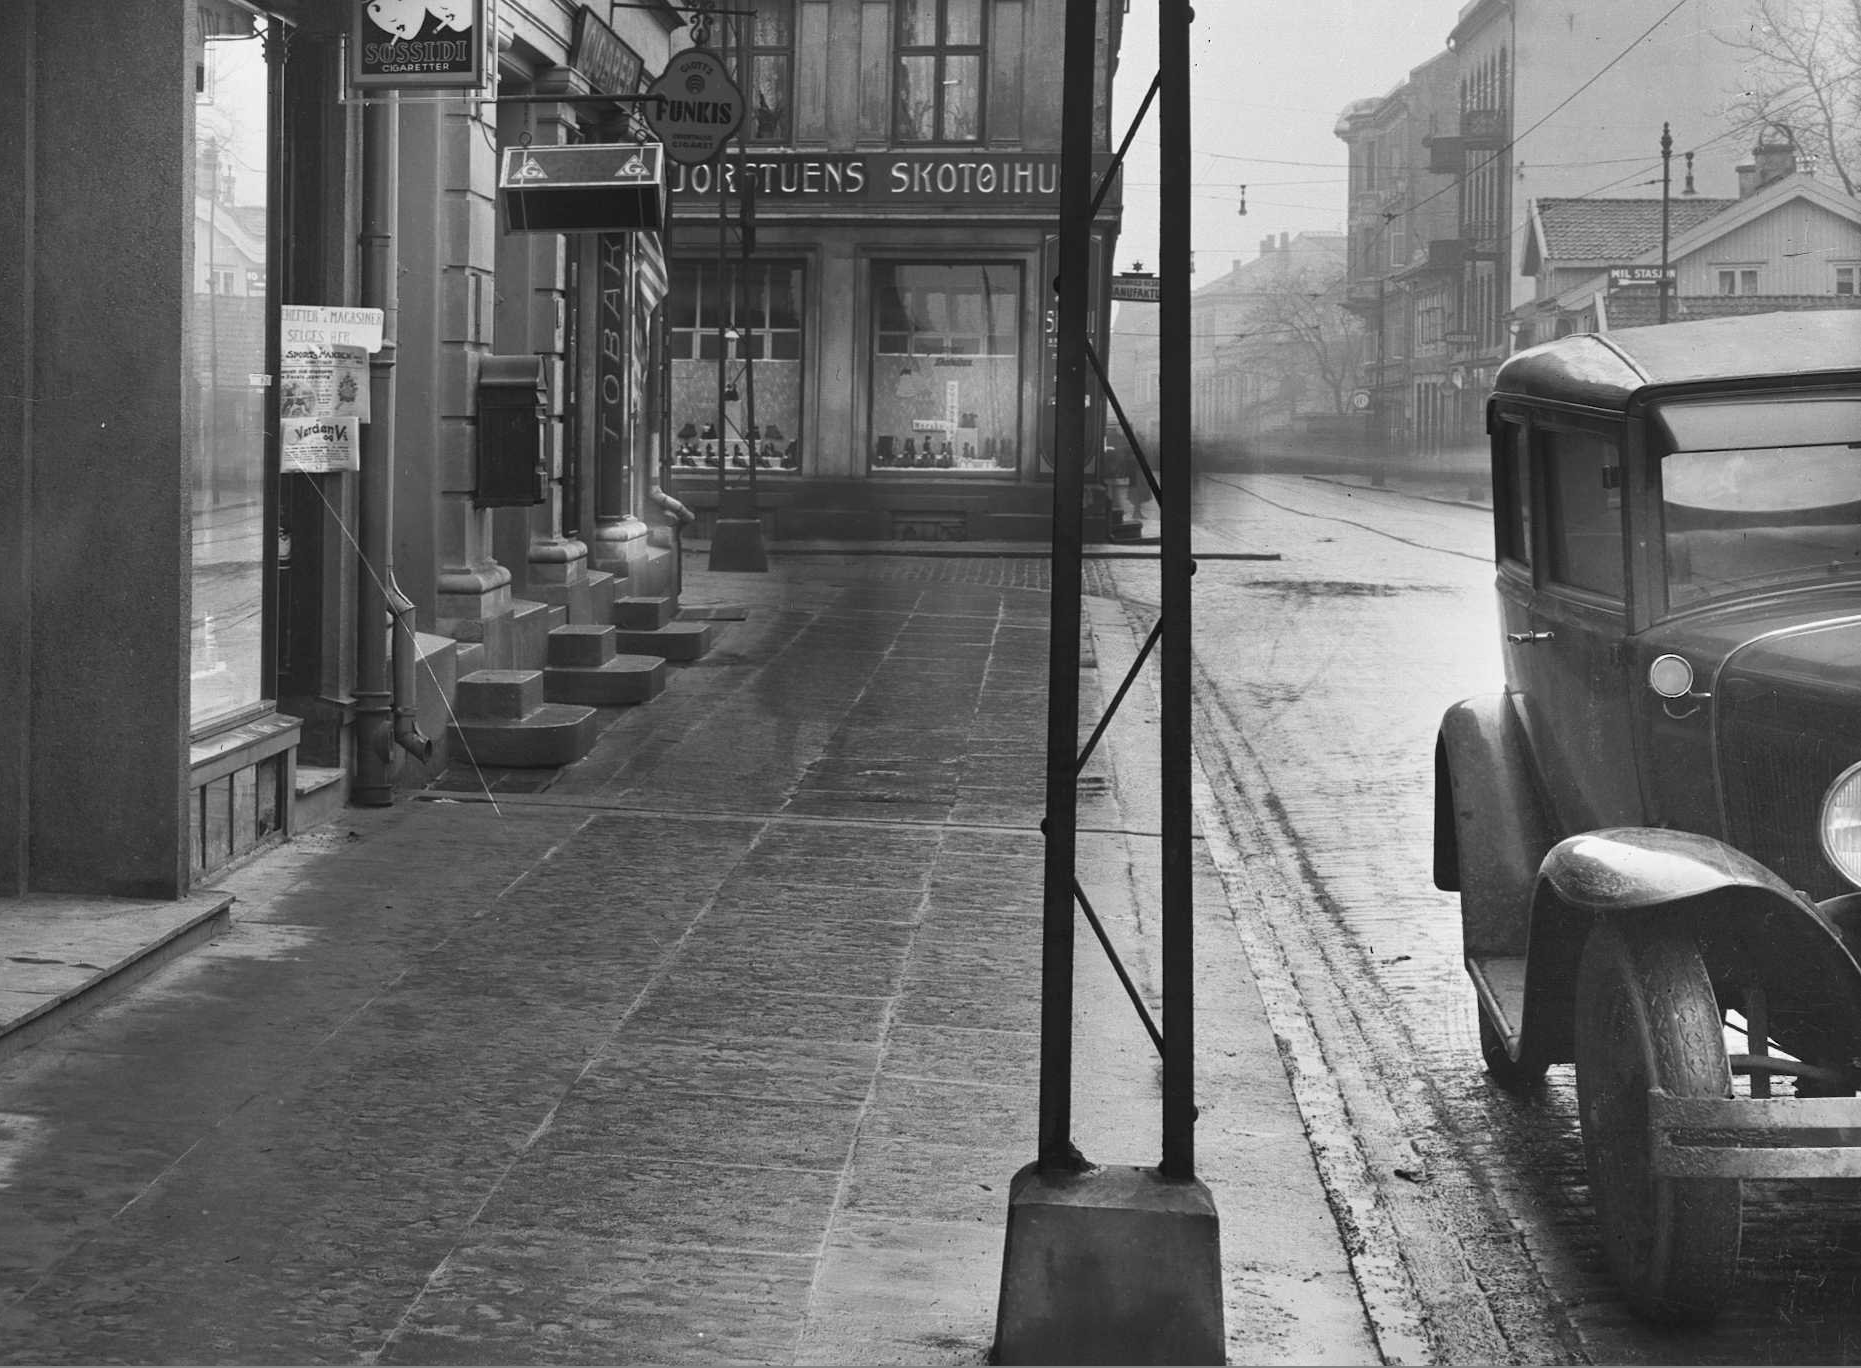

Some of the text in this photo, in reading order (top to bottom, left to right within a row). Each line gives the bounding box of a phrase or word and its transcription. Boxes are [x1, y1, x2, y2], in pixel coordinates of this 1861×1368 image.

[364, 40, 468, 64] SOSSIDI
[382, 63, 450, 72] CIGARETTER
[656, 99, 732, 125] FUNKIS
[672, 163, 864, 193] JORSTUENS
[891, 163, 1060, 193] SKOTØIHU
[1634, 269, 1675, 278] STASJN
[1114, 287, 1160, 299] ANUFAKTU
[603, 237, 621, 442] TOBAK
